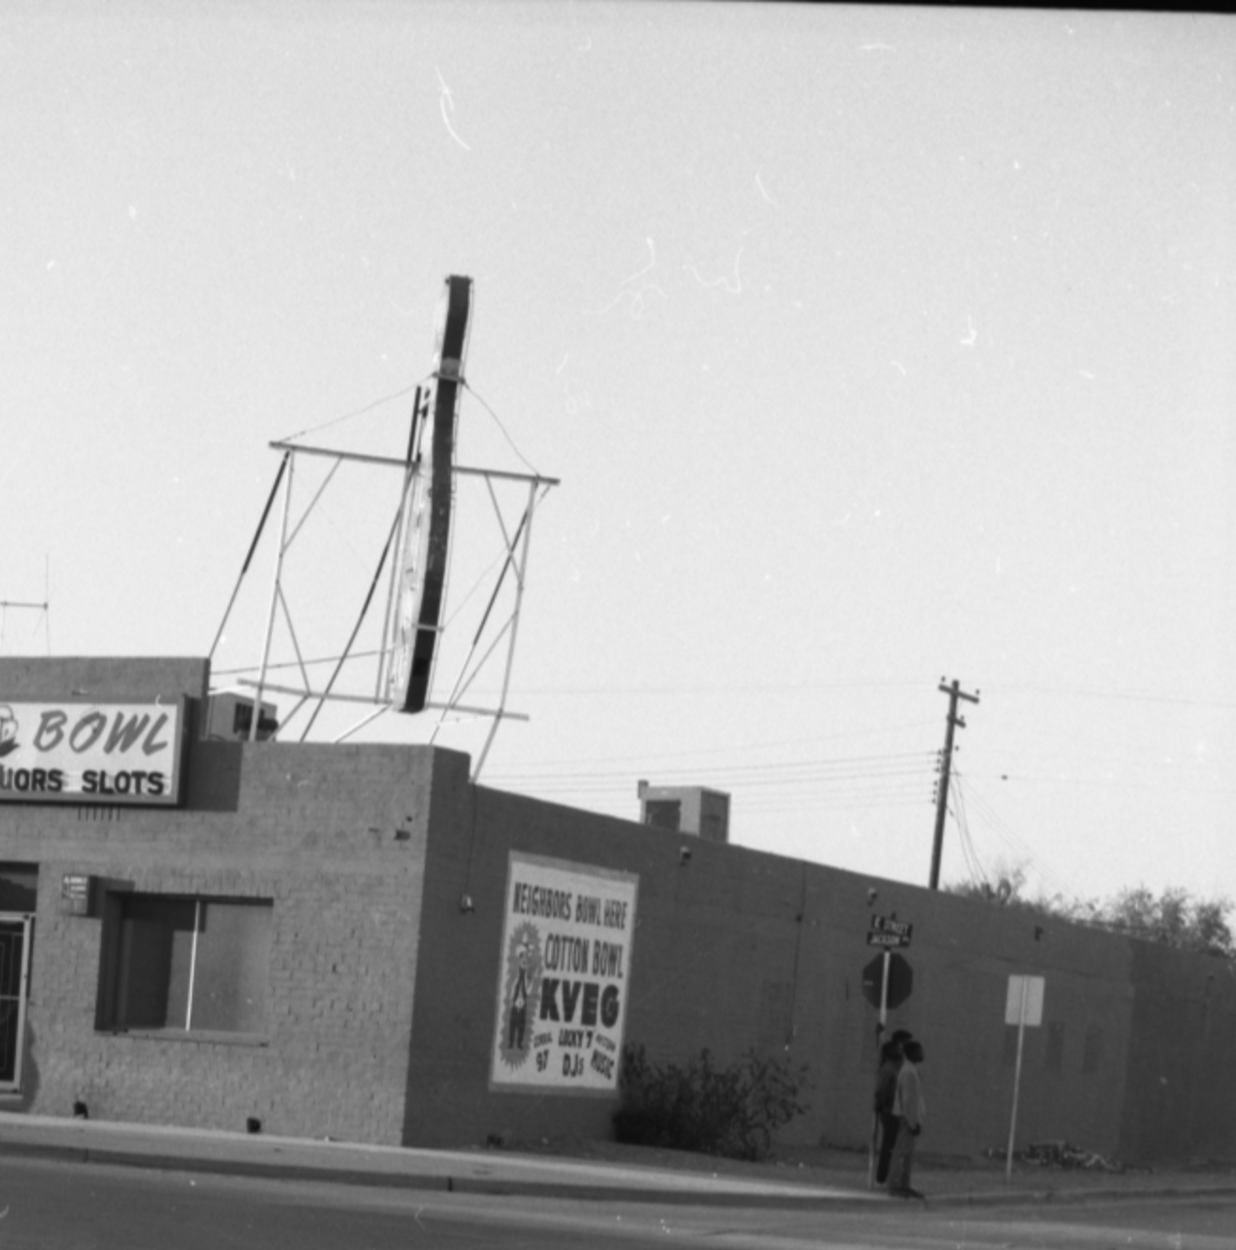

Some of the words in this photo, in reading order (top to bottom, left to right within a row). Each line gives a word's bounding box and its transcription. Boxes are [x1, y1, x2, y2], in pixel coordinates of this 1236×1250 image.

[33, 709, 169, 756] BOWL
[81, 769, 165, 796] SLOTS
[513, 882, 572, 922] NEIGHBORS
[575, 894, 602, 926] BOWL
[604, 898, 628, 930] HERE
[544, 933, 590, 973] COTTON
[592, 939, 624, 979] BOWL
[539, 977, 620, 1028] KVEG
[558, 1028, 584, 1048] LUCKY
[586, 1030, 593, 1048] 7
